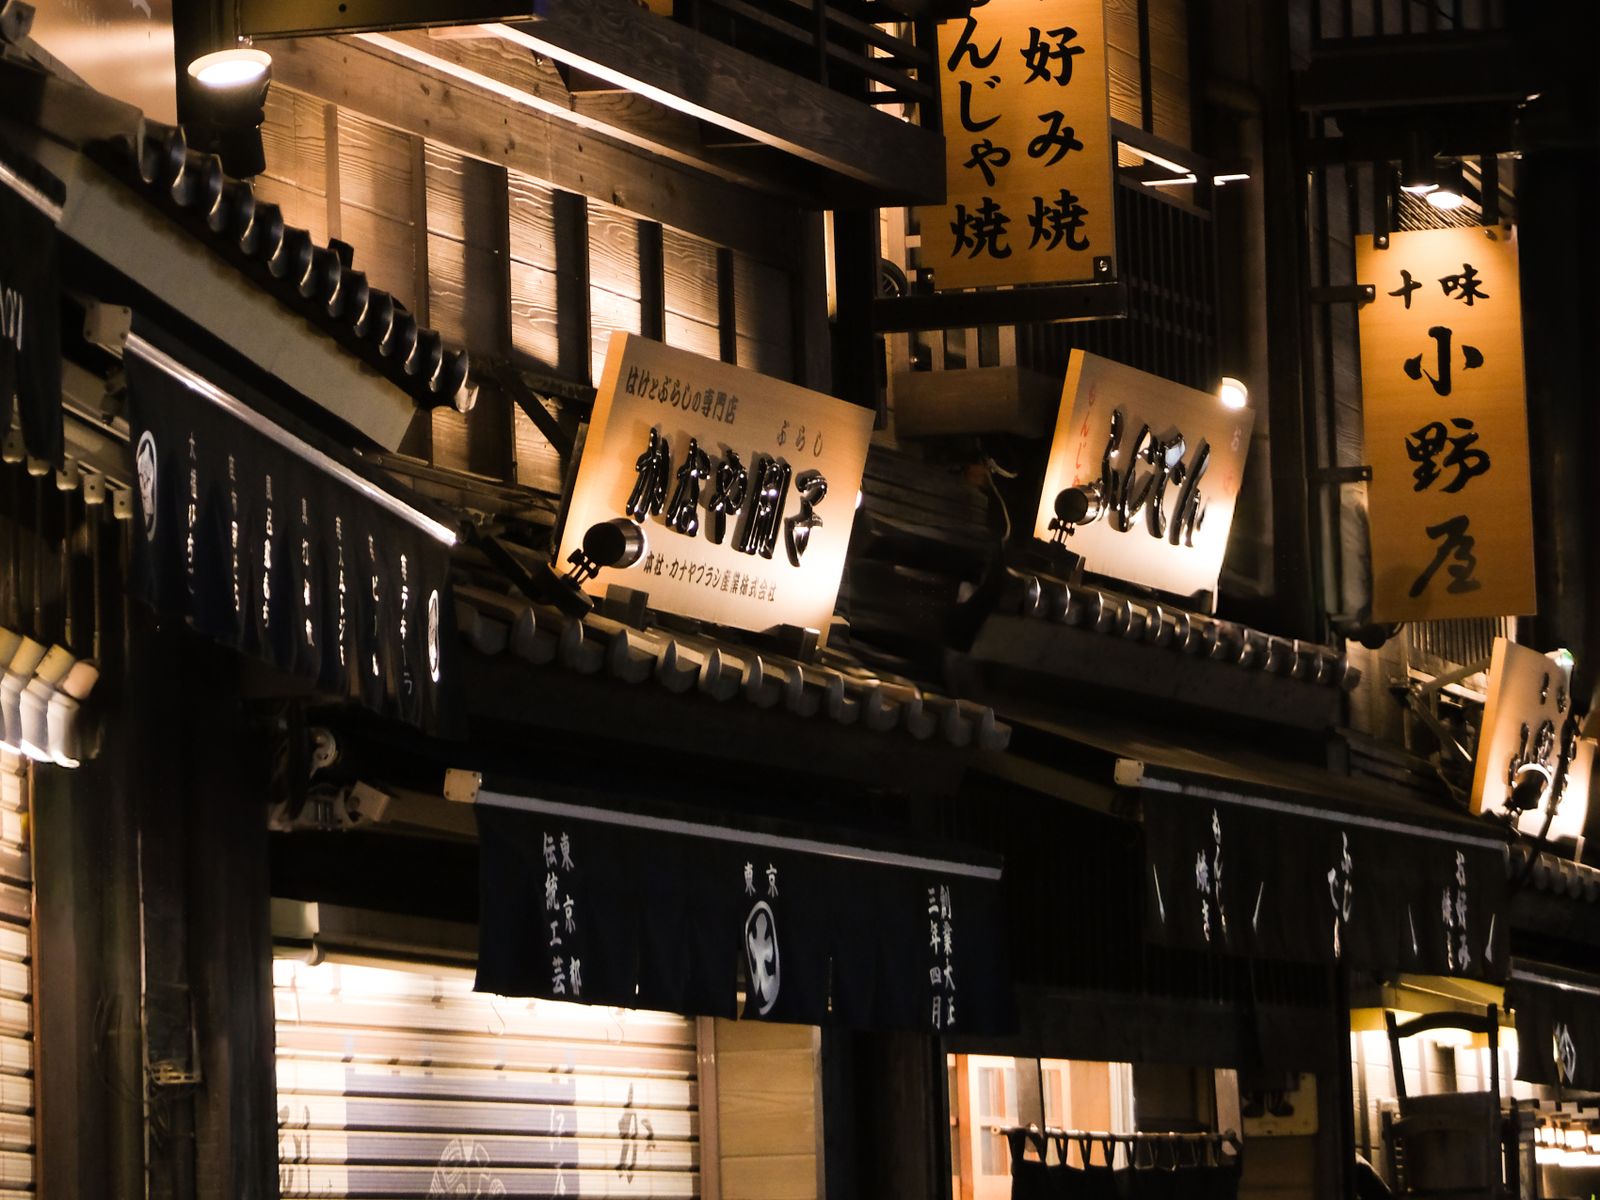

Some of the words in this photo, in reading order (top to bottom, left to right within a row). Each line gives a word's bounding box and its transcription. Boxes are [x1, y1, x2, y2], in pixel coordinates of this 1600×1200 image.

[1388, 263, 1490, 310] 十味
[625, 365, 739, 425] はけとぶらしの専門店
[777, 420, 824, 458] ぶらし
[1403, 326, 1491, 599] 小野屋
[542, 831, 566, 995] 伝統工芸
[559, 831, 583, 997] 東京都
[743, 861, 779, 898] 東京
[927, 887, 942, 1032] 三年四月
